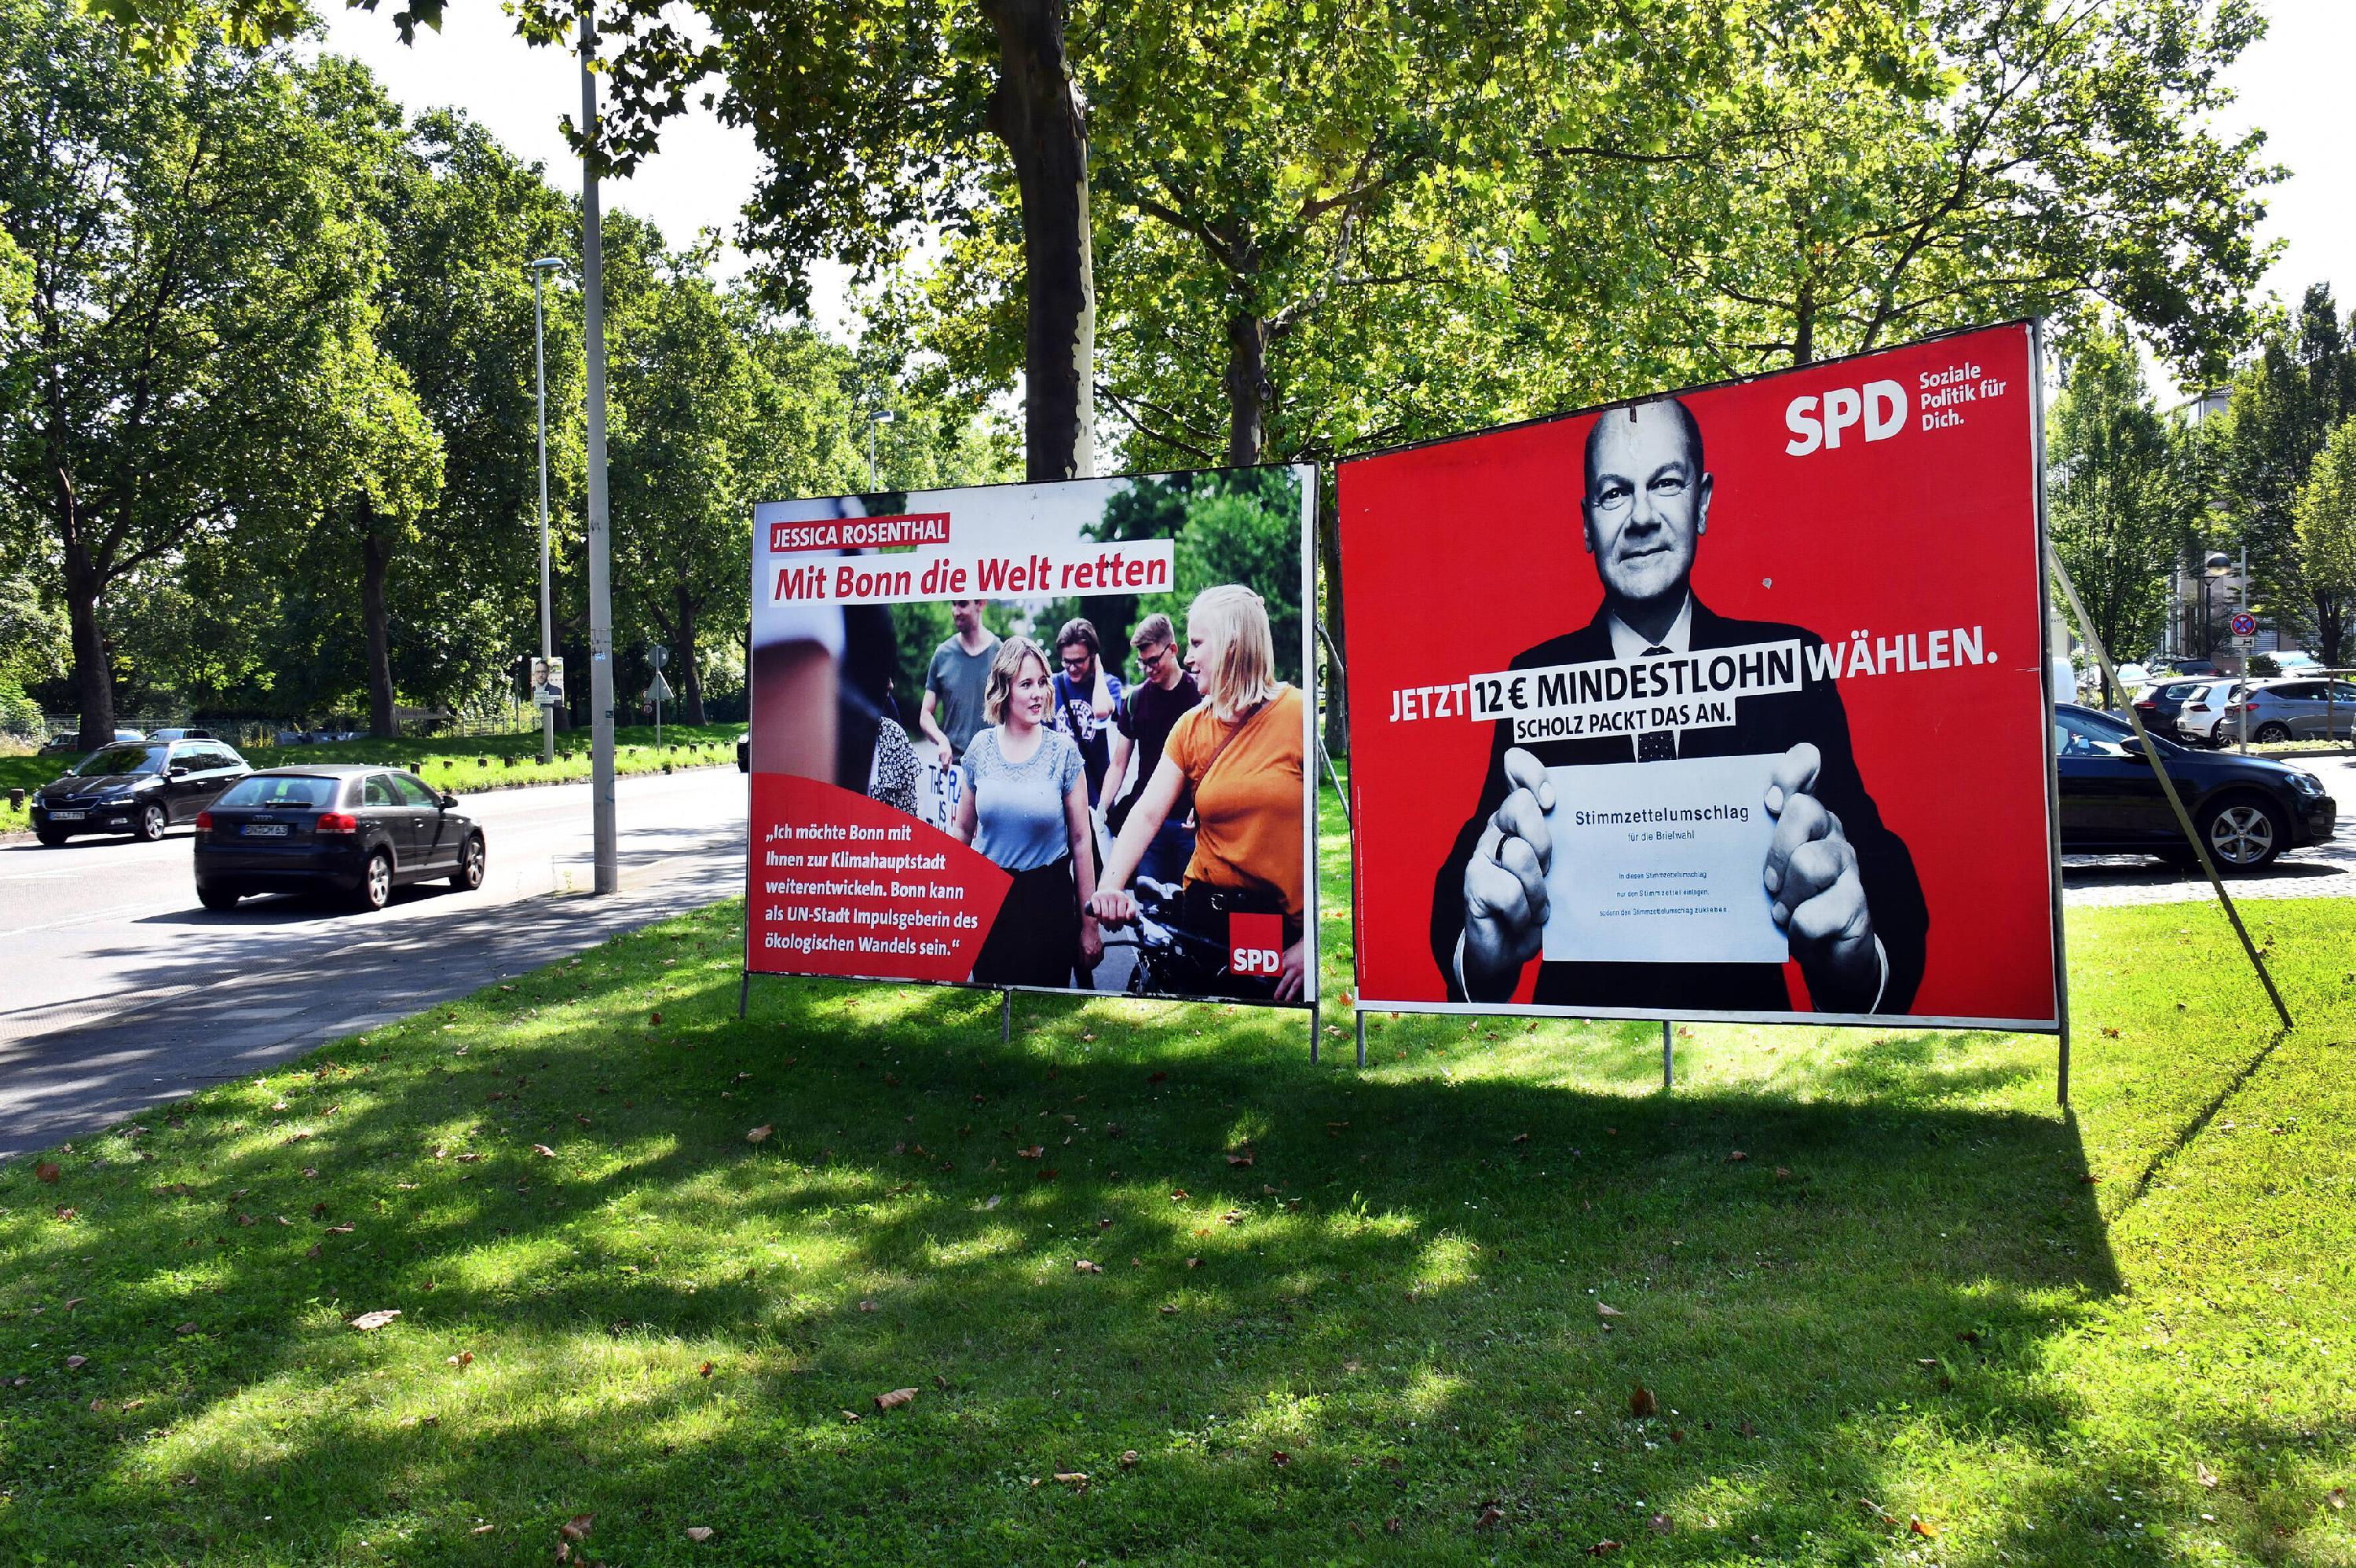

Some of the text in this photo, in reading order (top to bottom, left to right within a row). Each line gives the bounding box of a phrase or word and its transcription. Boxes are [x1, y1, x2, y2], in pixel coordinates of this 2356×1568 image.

[1919, 362, 1981, 389] Soziale
[1921, 378, 2007, 410] Politik für
[1785, 379, 1908, 457] SPD
[1922, 409, 1964, 431] Dich.
[774, 519, 946, 548] JESSICA ROSENTHAL
[774, 553, 1166, 600] Mit Bonn die Welt retten
[1389, 626, 1998, 722] JETZT 12 € MINDESTLOHN WÄHLEN.
[1517, 702, 1732, 739] SCHOLZ PACKT DAS AN.
[928, 765, 944, 795] THE
[1575, 804, 1749, 826] Stimmzettelumschlag
[796, 824, 846, 840] möchte
[849, 824, 884, 840] Bonn
[887, 824, 912, 841] mit
[1628, 830, 1695, 842] für die Briefwahl
[766, 850, 946, 873] Ihnen zur Klimahauptstadt
[766, 878, 964, 899] weiterentwickeln. Bonn kann
[765, 905, 978, 930] als UN-Stadt Impulsgeberin des
[765, 932, 854, 954] ökologischen
[858, 936, 916, 955] Wandels
[1234, 948, 1279, 973] SPD
